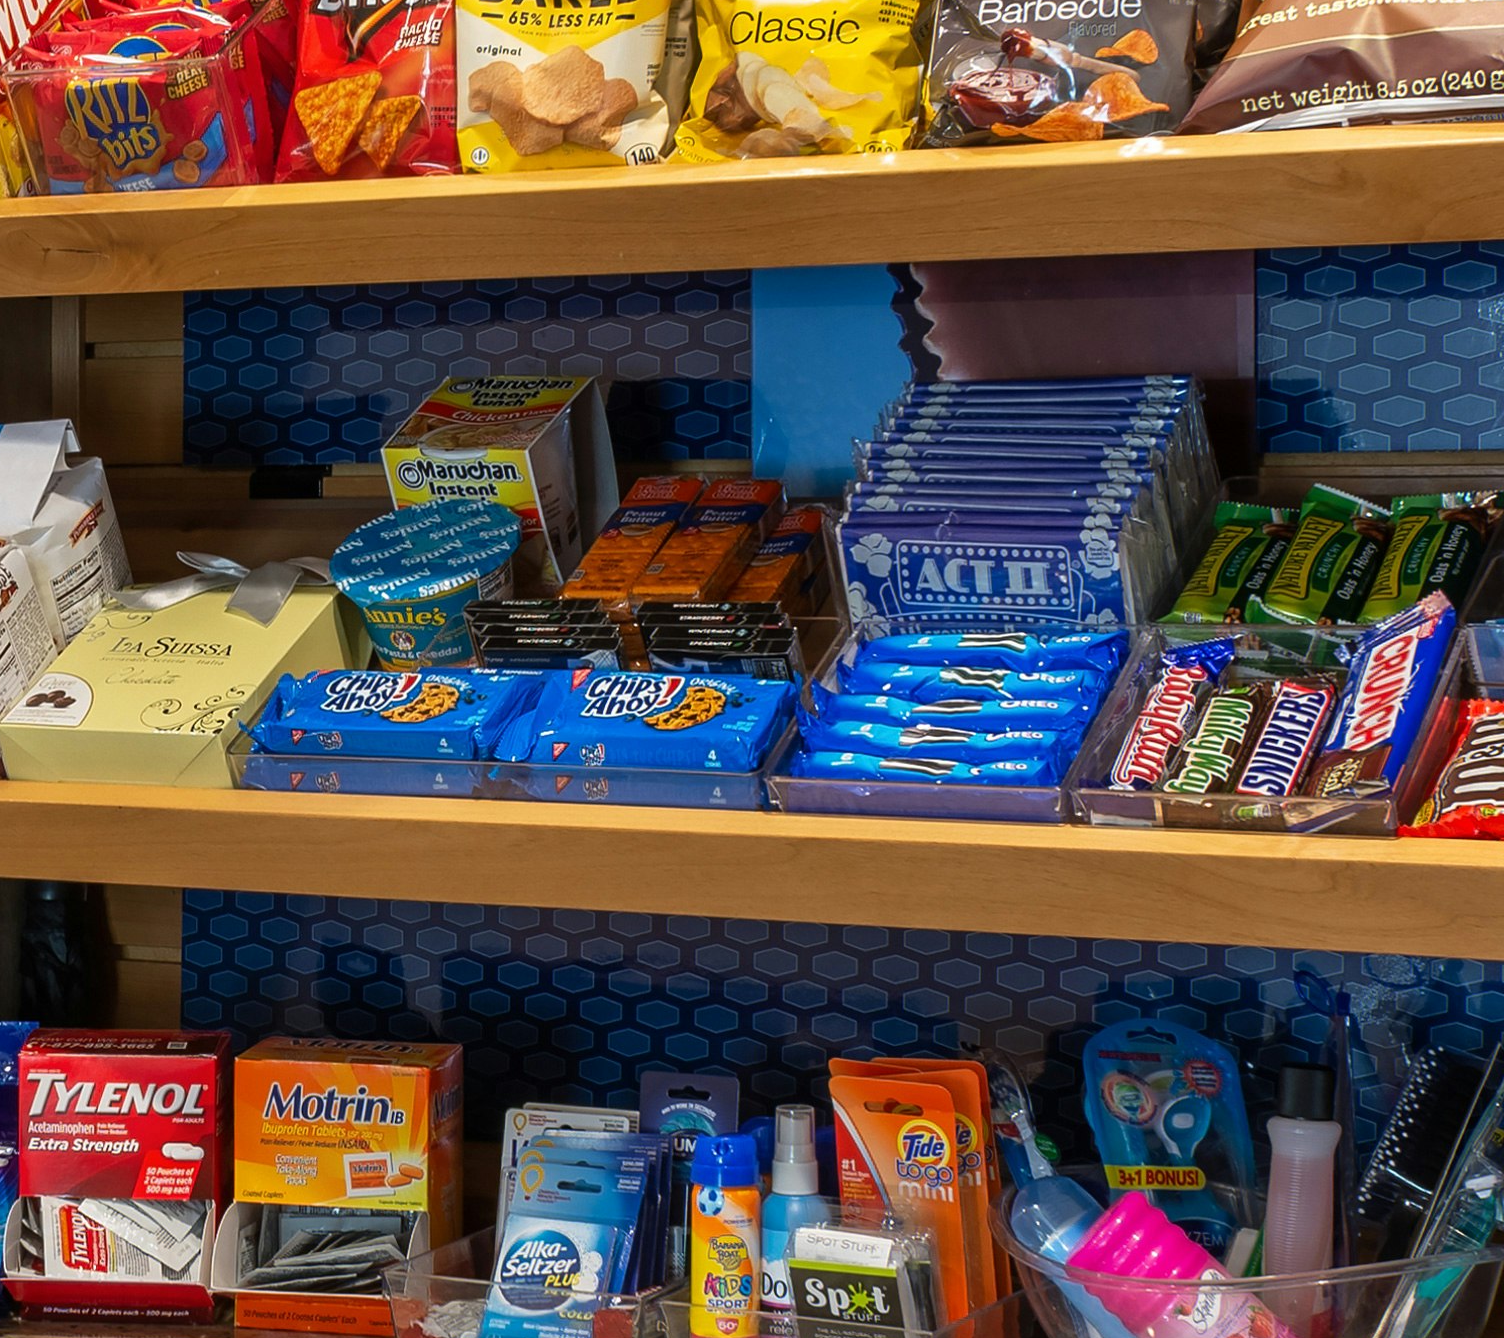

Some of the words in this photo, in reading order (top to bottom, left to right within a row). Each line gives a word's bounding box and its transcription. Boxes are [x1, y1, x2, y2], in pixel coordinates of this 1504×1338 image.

[509, 11, 542, 26] 65%
[549, 12, 583, 29] LESS
[587, 11, 614, 27] FAT
[729, 10, 860, 45] Classic
[1068, 21, 1117, 37] Flavored
[476, 45, 522, 57] original
[167, 78, 209, 99] CHEESE
[1242, 90, 1285, 114] net
[1291, 77, 1374, 111] weight
[1411, 79, 1439, 96] oz
[68, 78, 149, 136] RITZ
[103, 124, 159, 167] bits
[472, 390, 541, 400] Instant
[452, 411, 521, 423] Chicken
[428, 482, 499, 497] Instant
[916, 558, 997, 595] ACT
[1003, 560, 1053, 595] II
[327, 673, 405, 701] Chips
[589, 674, 666, 700] Chips
[1343, 635, 1420, 751] CRUNCH
[1242, 689, 1328, 796] SNICKERS
[27, 1072, 205, 1117] TYLENOL
[263, 1081, 391, 1125] Motrin
[391, 1110, 405, 1125] IB
[28, 1120, 94, 1136] Acetaminophen
[262, 1122, 310, 1136] Ibuprofen
[311, 1124, 346, 1137] Tablets
[28, 1137, 69, 1151] Extra
[72, 1138, 140, 1154] Strength
[902, 1132, 945, 1160] Tide
[275, 1153, 319, 1165] Convenient
[157, 1167, 186, 1176] Pouches
[1118, 1169, 1142, 1186] 3+1
[1145, 1169, 1199, 1187] BONUS!
[152, 1176, 174, 1186] Caplets
[176, 1176, 192, 1185] each
[173, 1185, 190, 1194] each
[898, 1180, 955, 1204] mini
[511, 1239, 568, 1258] Alka-
[807, 1232, 839, 1247] SPOT
[502, 1255, 577, 1279] Seltzer
[707, 1298, 750, 1310] SPORT
[841, 1311, 882, 1325] STUFF
